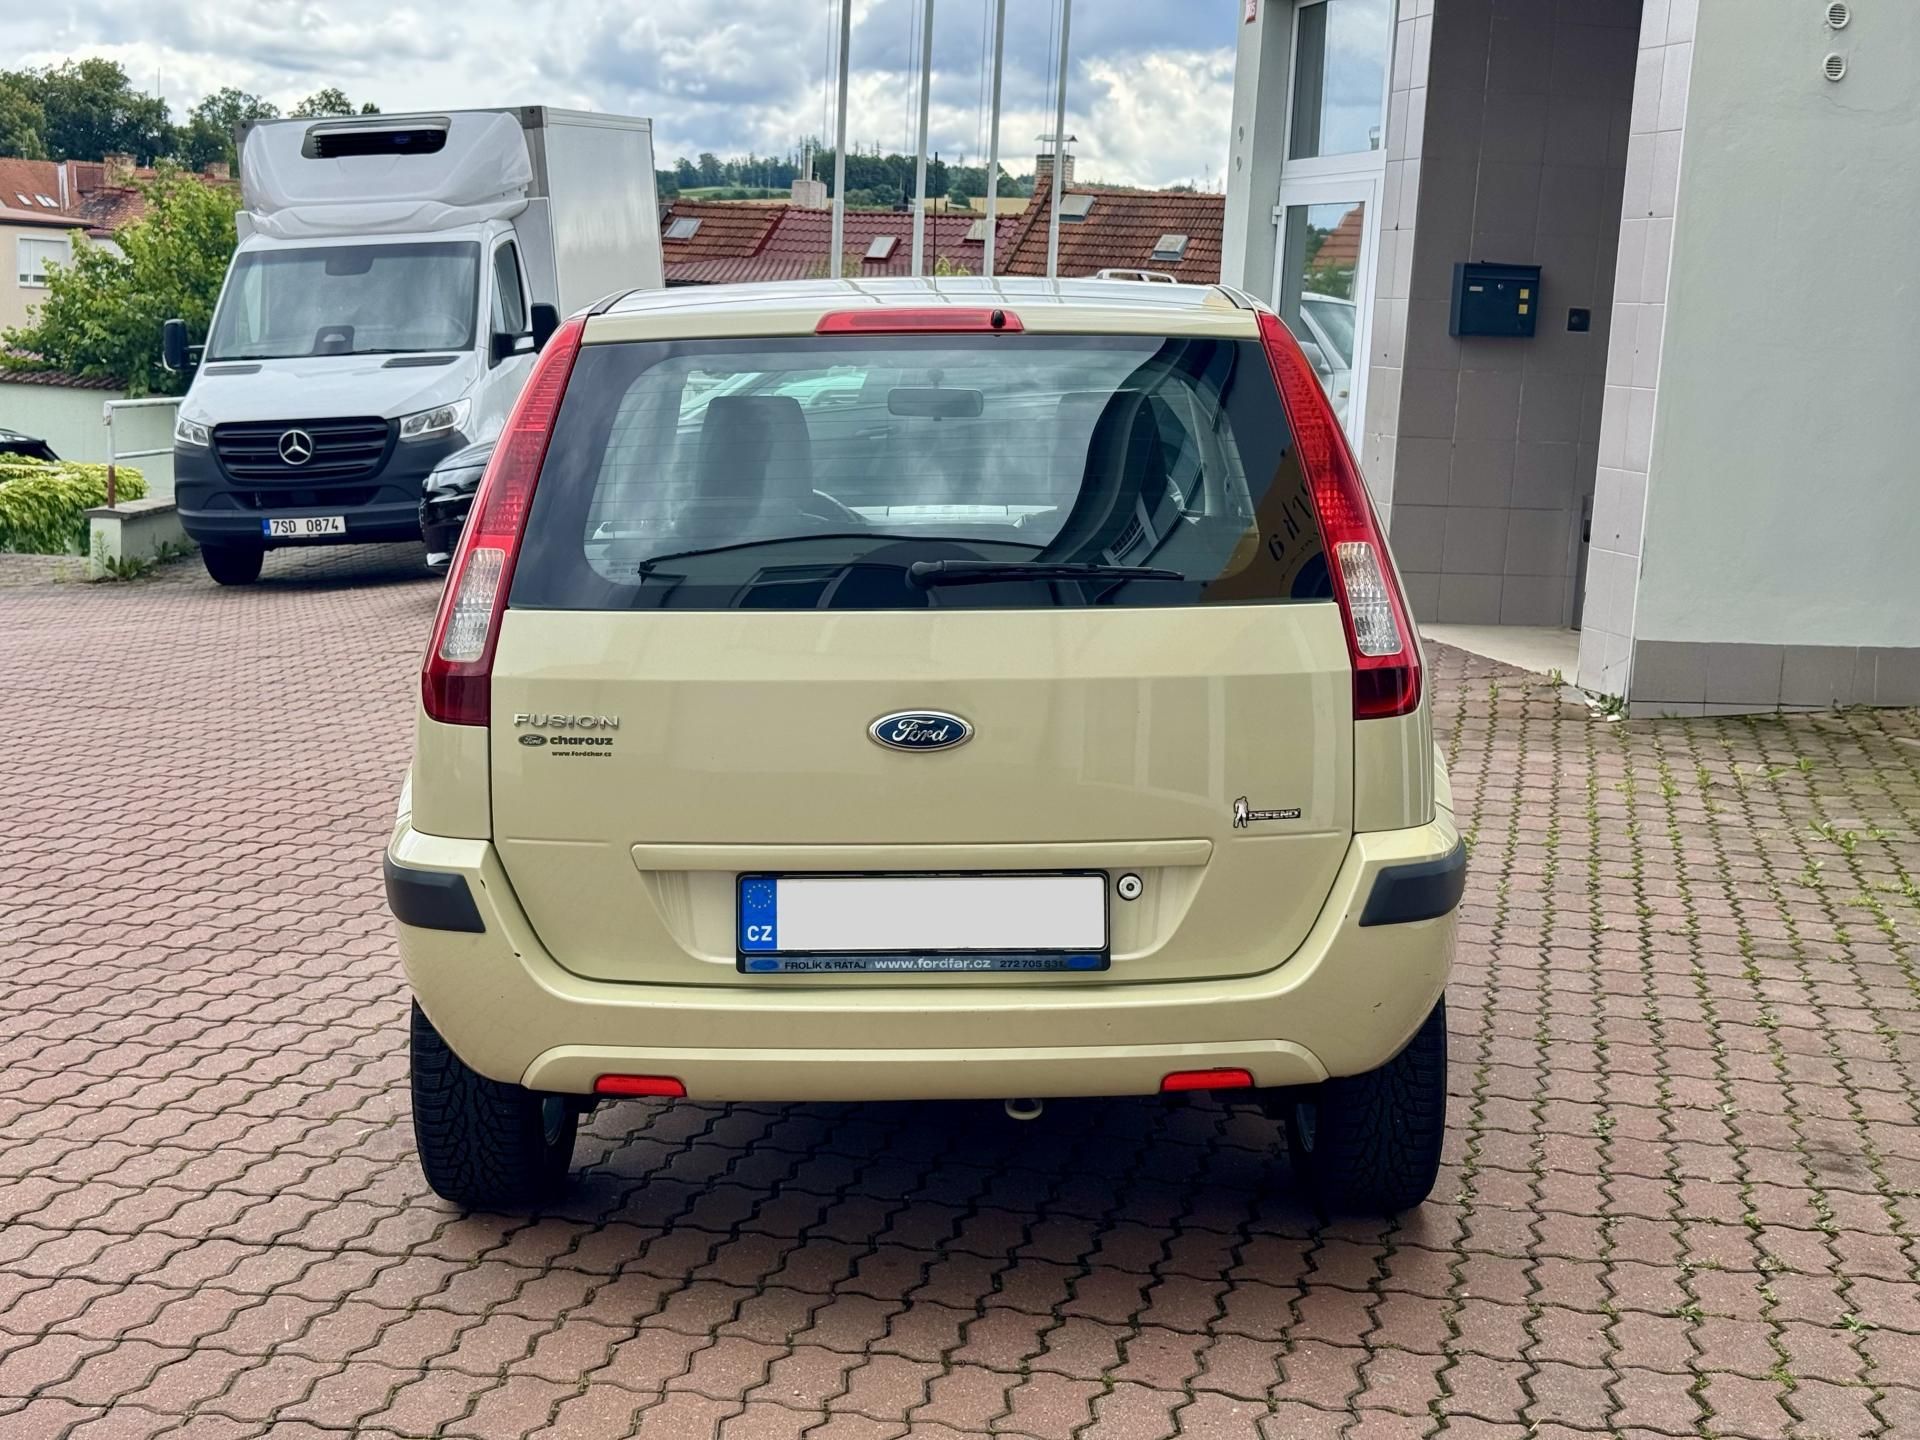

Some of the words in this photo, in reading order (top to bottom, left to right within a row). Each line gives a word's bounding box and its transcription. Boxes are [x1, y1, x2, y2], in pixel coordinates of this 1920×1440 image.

[272, 519, 297, 534] 7SD
[306, 518, 339, 533] 0874
[513, 713, 620, 730] FUSION
[892, 718, 950, 742] Ford
[549, 735, 614, 746] charouz
[1248, 810, 1299, 820] DEFEND
[747, 925, 773, 942] CZ
[824, 961, 832, 970] &
[875, 957, 992, 969] www.fordfar.cz
[1000, 960, 1020, 969] 272
[1022, 960, 1042, 969] 705
